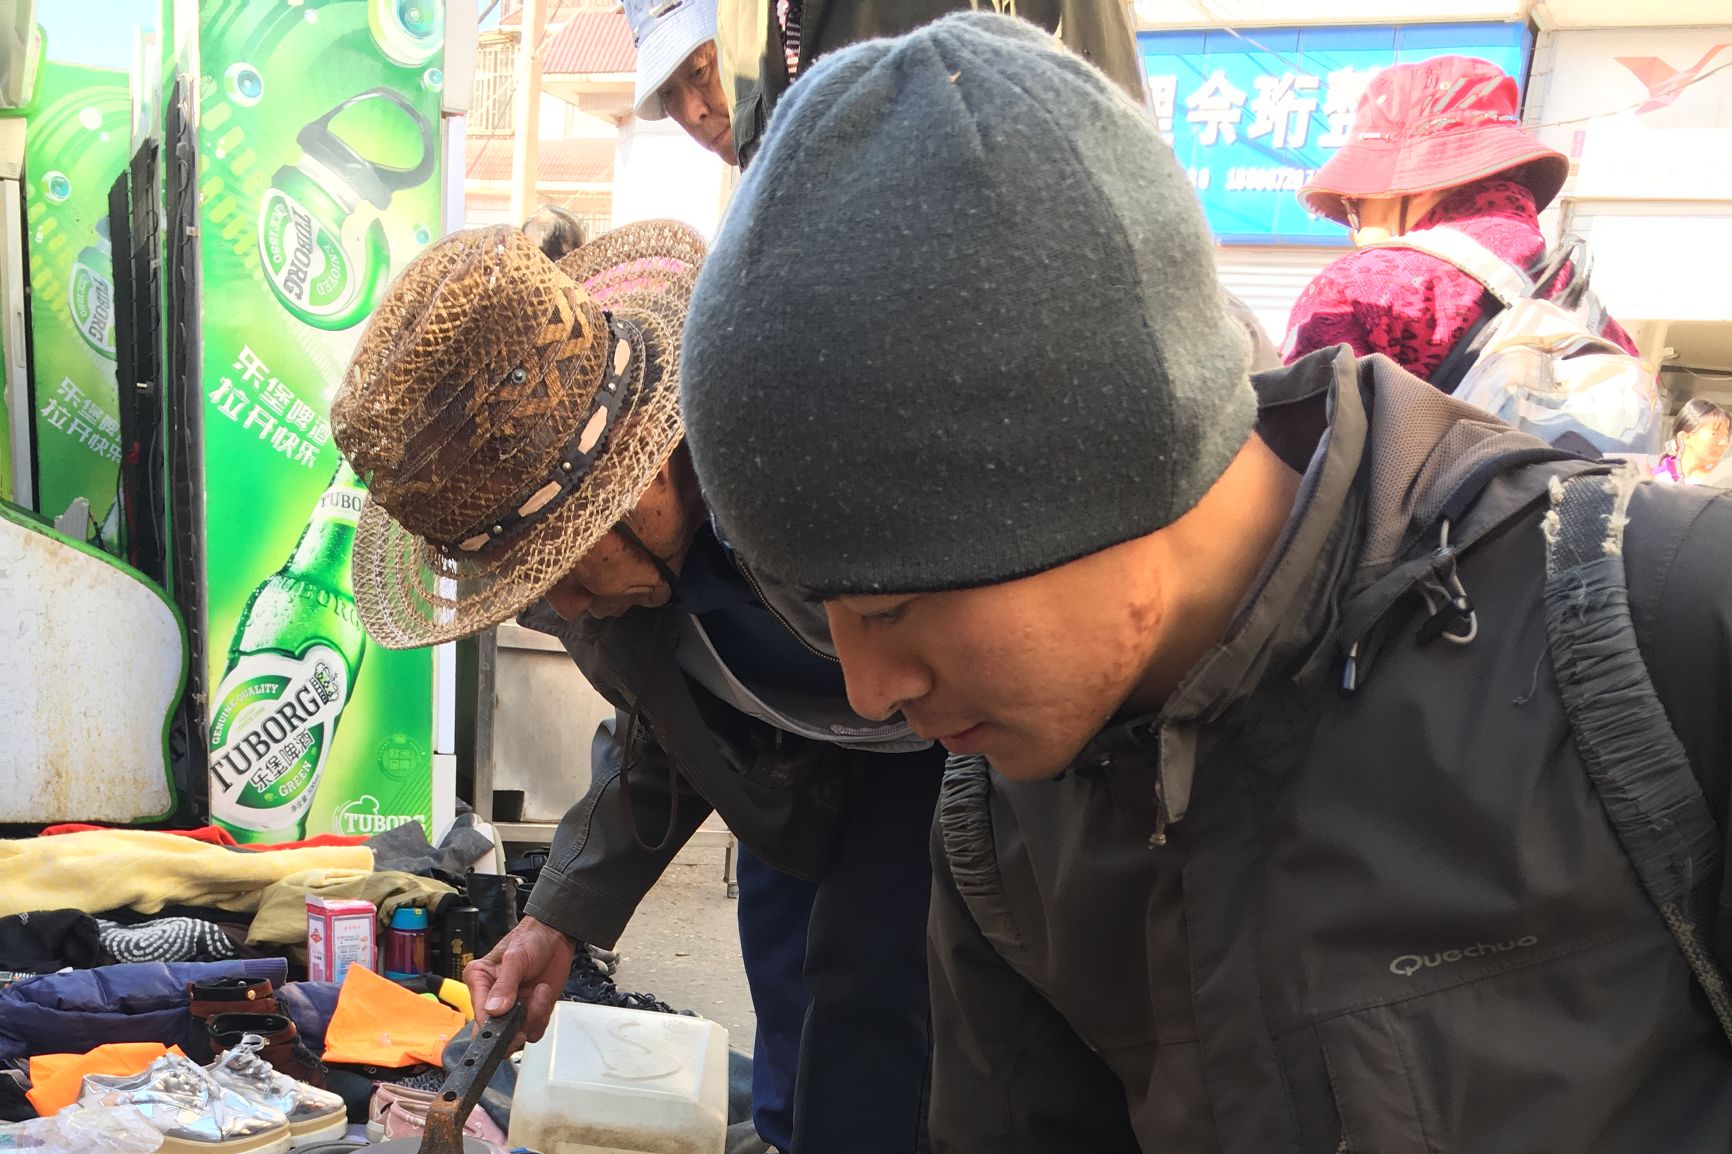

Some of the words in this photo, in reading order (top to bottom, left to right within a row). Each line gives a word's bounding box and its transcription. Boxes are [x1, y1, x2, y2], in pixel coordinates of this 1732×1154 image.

[283, 206, 313, 301] TUBORG
[57, 376, 121, 442] 乐堡啤
[208, 376, 320, 469] 拉开快乐
[232, 344, 331, 446] 乐堡啤酒
[210, 684, 320, 794] TUBORG
[251, 728, 313, 793] 乐堡啤酒
[279, 760, 313, 797] GREEN
[1389, 936, 1538, 977] Quechua
